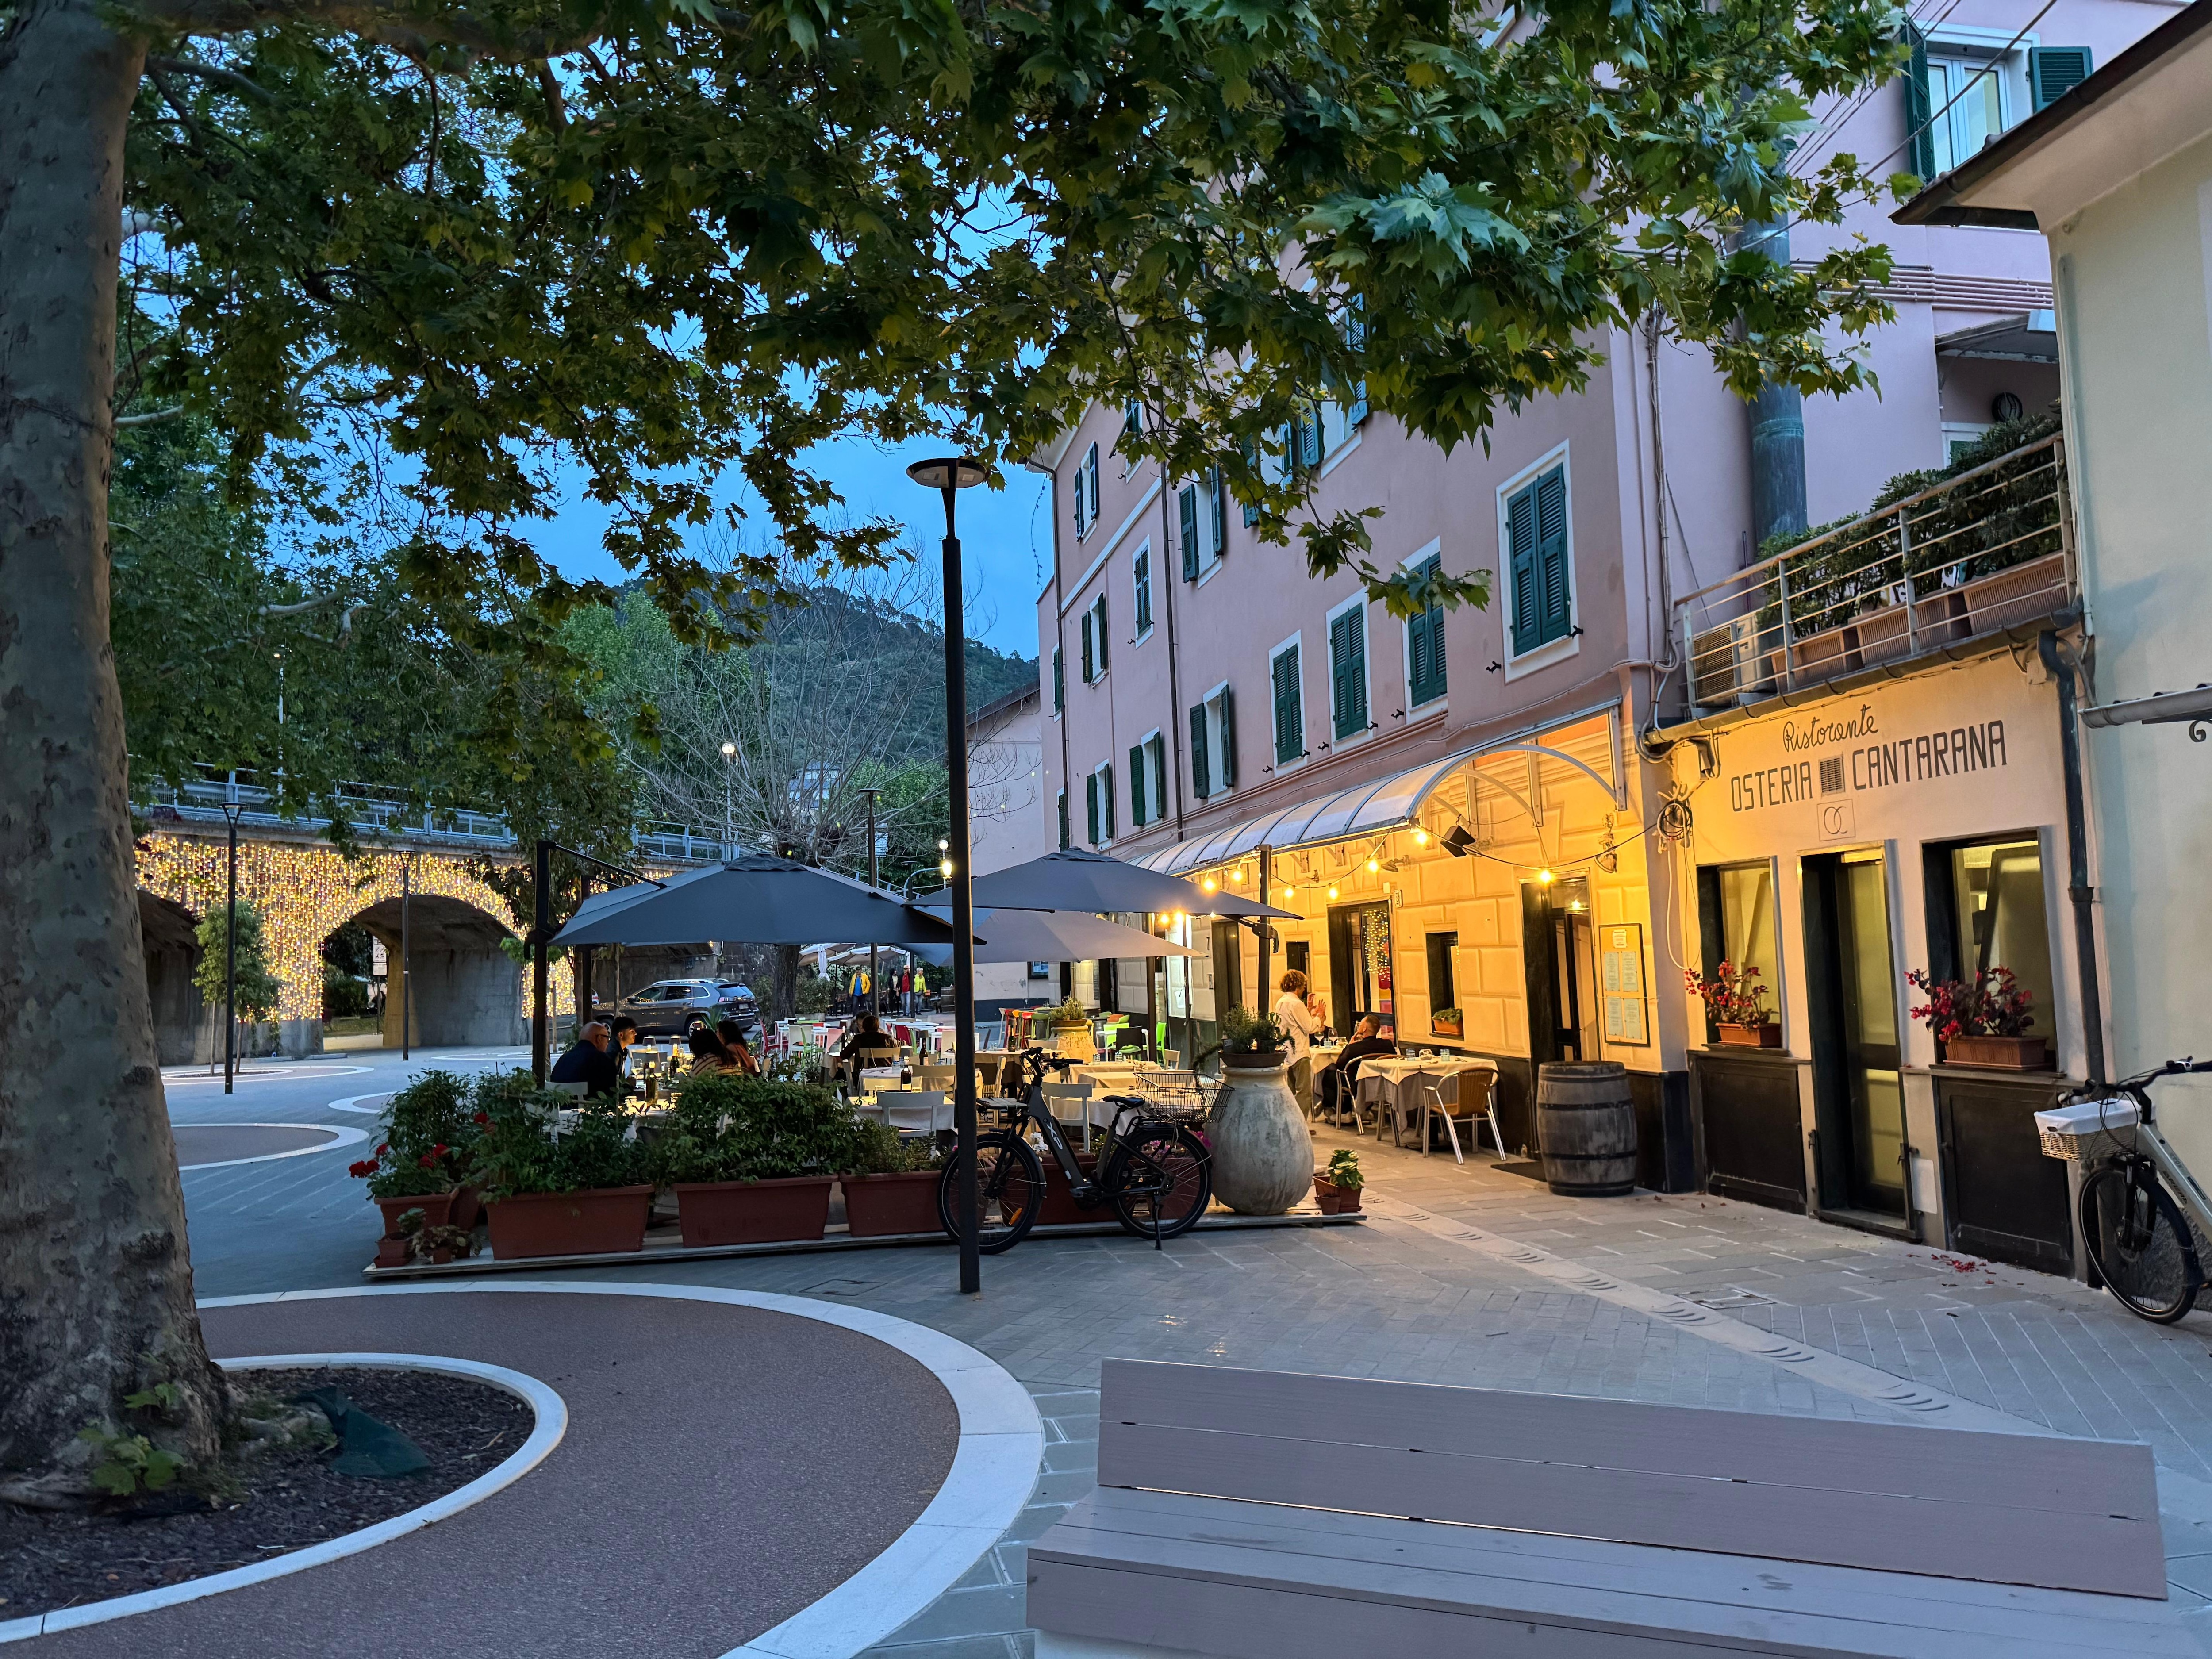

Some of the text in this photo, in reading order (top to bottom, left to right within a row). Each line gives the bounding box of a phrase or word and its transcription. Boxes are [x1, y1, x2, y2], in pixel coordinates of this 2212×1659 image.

[1783, 704, 1879, 753] Ristorante
[1731, 719, 2008, 812] OSTERIA CANTARANA
